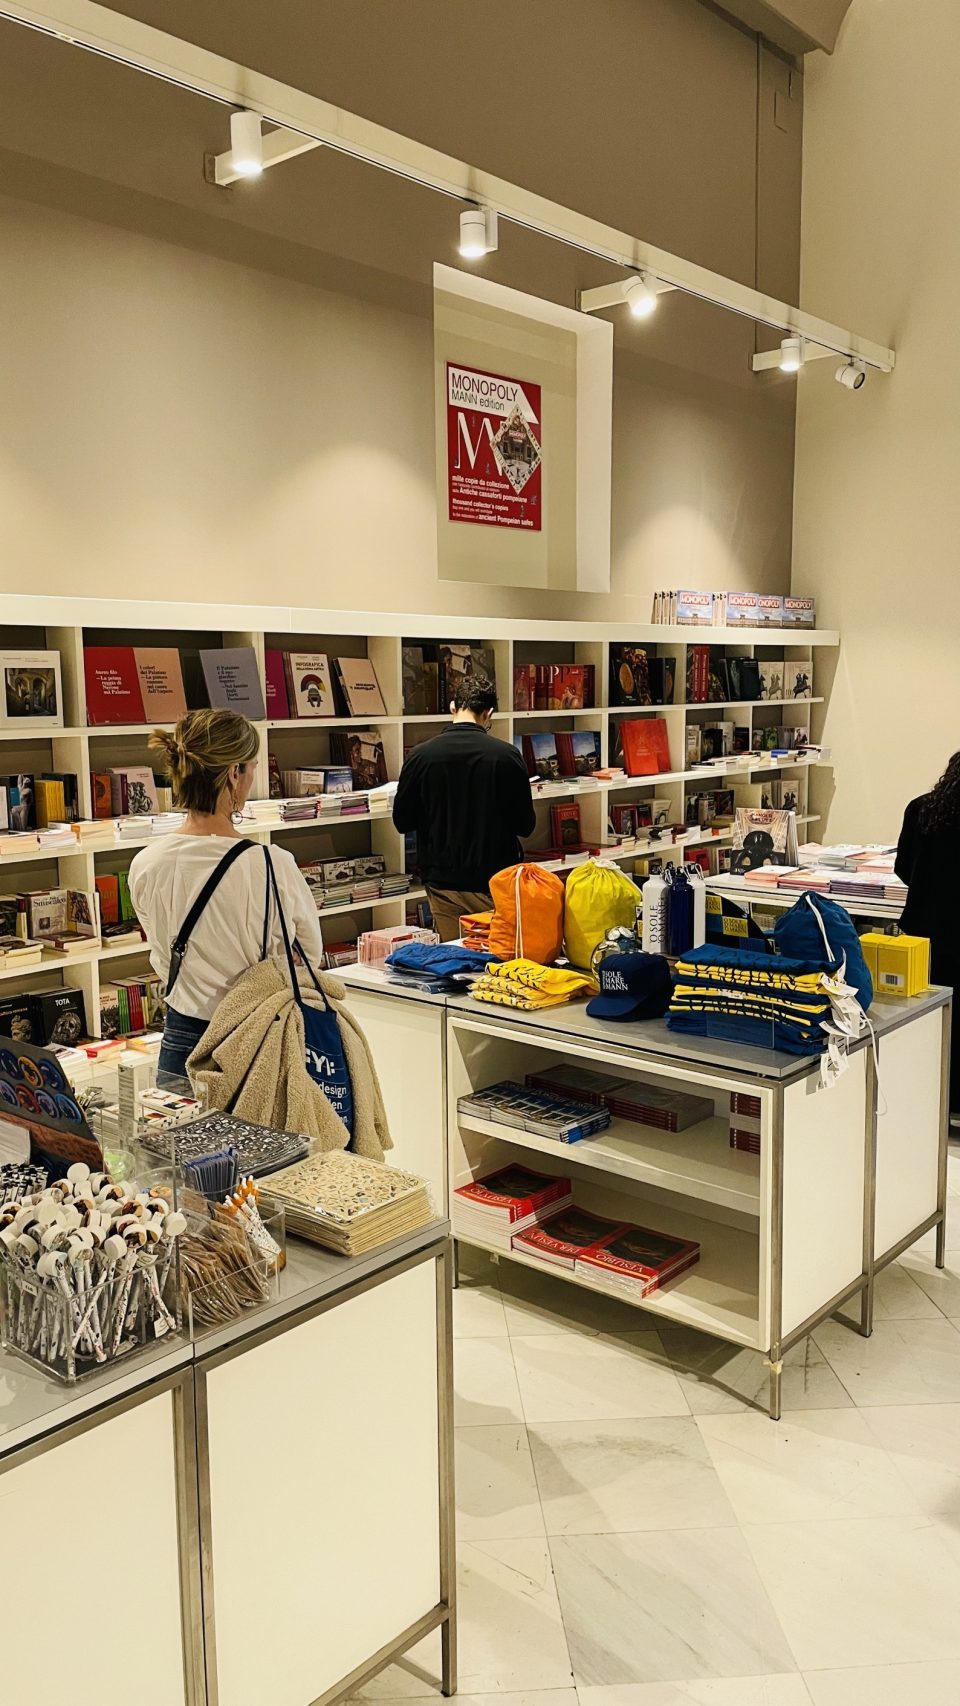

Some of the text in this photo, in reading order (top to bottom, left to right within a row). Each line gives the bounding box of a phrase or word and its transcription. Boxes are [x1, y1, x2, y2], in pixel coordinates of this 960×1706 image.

[452, 372, 518, 402] MONOPOLY
[452, 390, 504, 411] MANN edition
[486, 480, 510, 489] collezione
[460, 487, 478, 496] Antiche
[479, 491, 502, 499] cassaforti
[503, 494, 527, 503] pompeiane
[452, 498, 472, 506] thousand
[473, 501, 494, 509] collector's
[497, 515, 520, 525] Pompeian
[682, 594, 710, 605] MONOPOLY
[730, 595, 756, 606] MONOPOLY
[758, 599, 780, 608] ONOPOLY
[785, 599, 812, 609] MONOPOLY
[649, 905, 658, 932] SOLE
[319, 1082, 347, 1098] design
[560, 1244, 580, 1254] DER
[596, 1253, 644, 1273] VESUBIO
